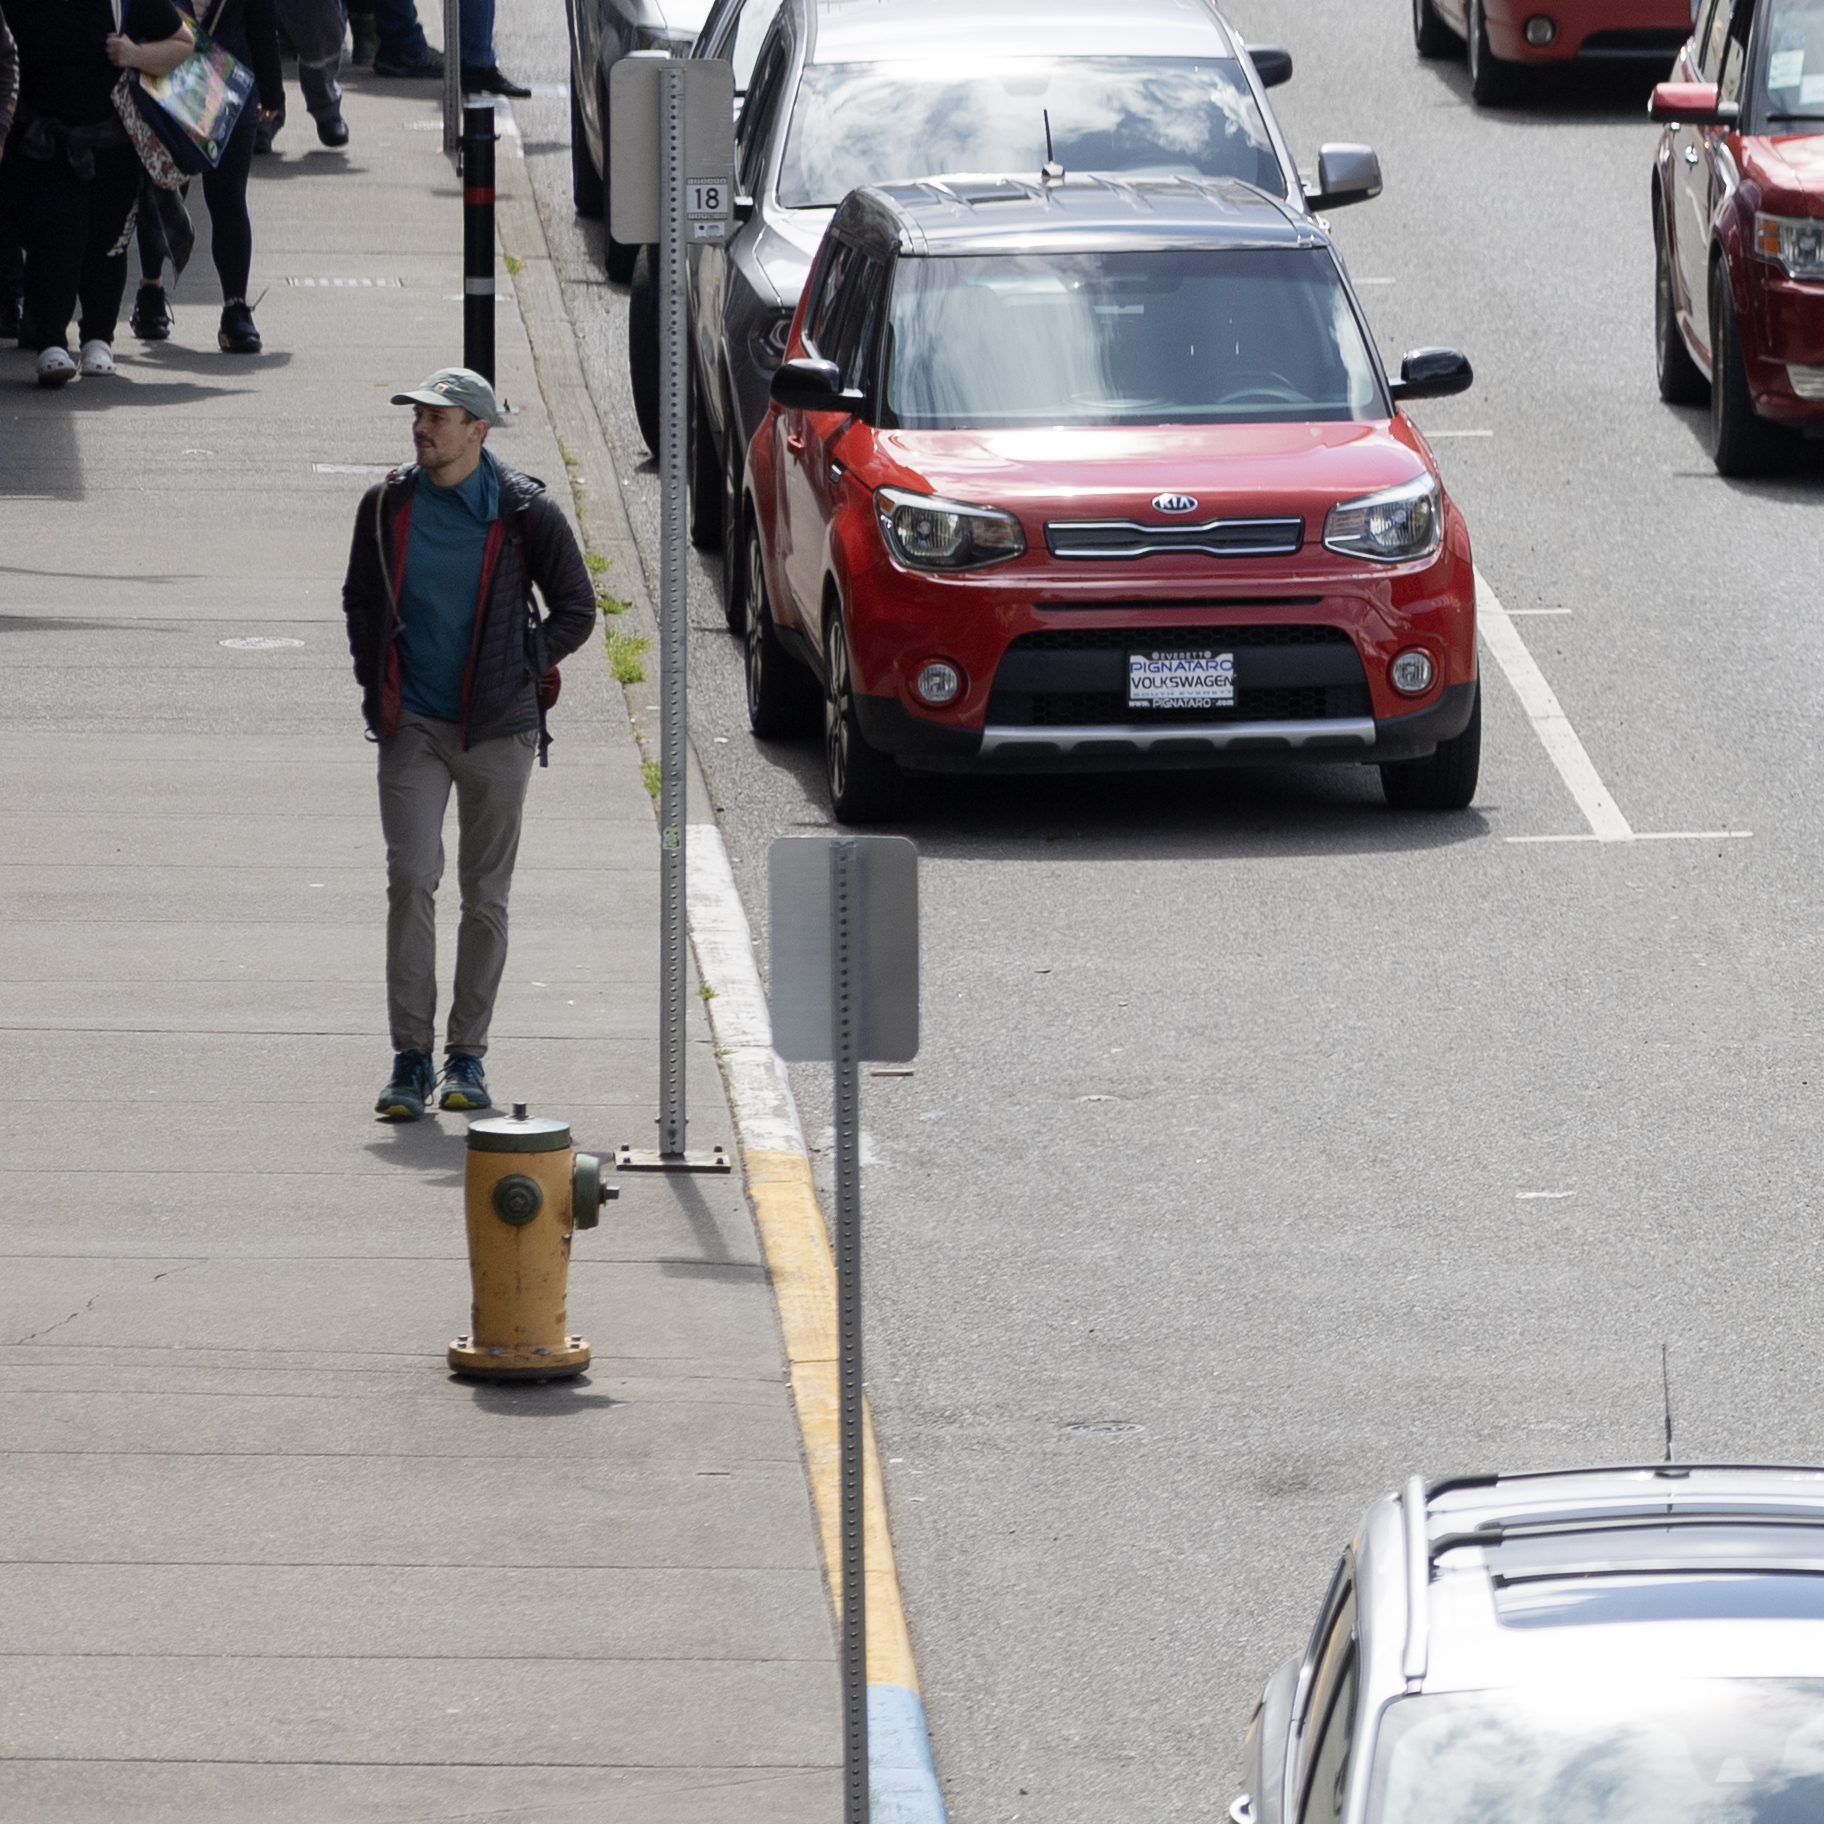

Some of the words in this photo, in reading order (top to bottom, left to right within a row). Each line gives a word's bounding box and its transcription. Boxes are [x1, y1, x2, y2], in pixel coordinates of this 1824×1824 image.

[695, 187, 720, 210] 18
[1159, 496, 1192, 509] KIA
[1160, 651, 1204, 660] EVERETT
[1129, 659, 1235, 674] PIGNATARO
[1131, 675, 1234, 689] VOLKSWAGEN
[1152, 698, 1212, 709] PIGNATARO
